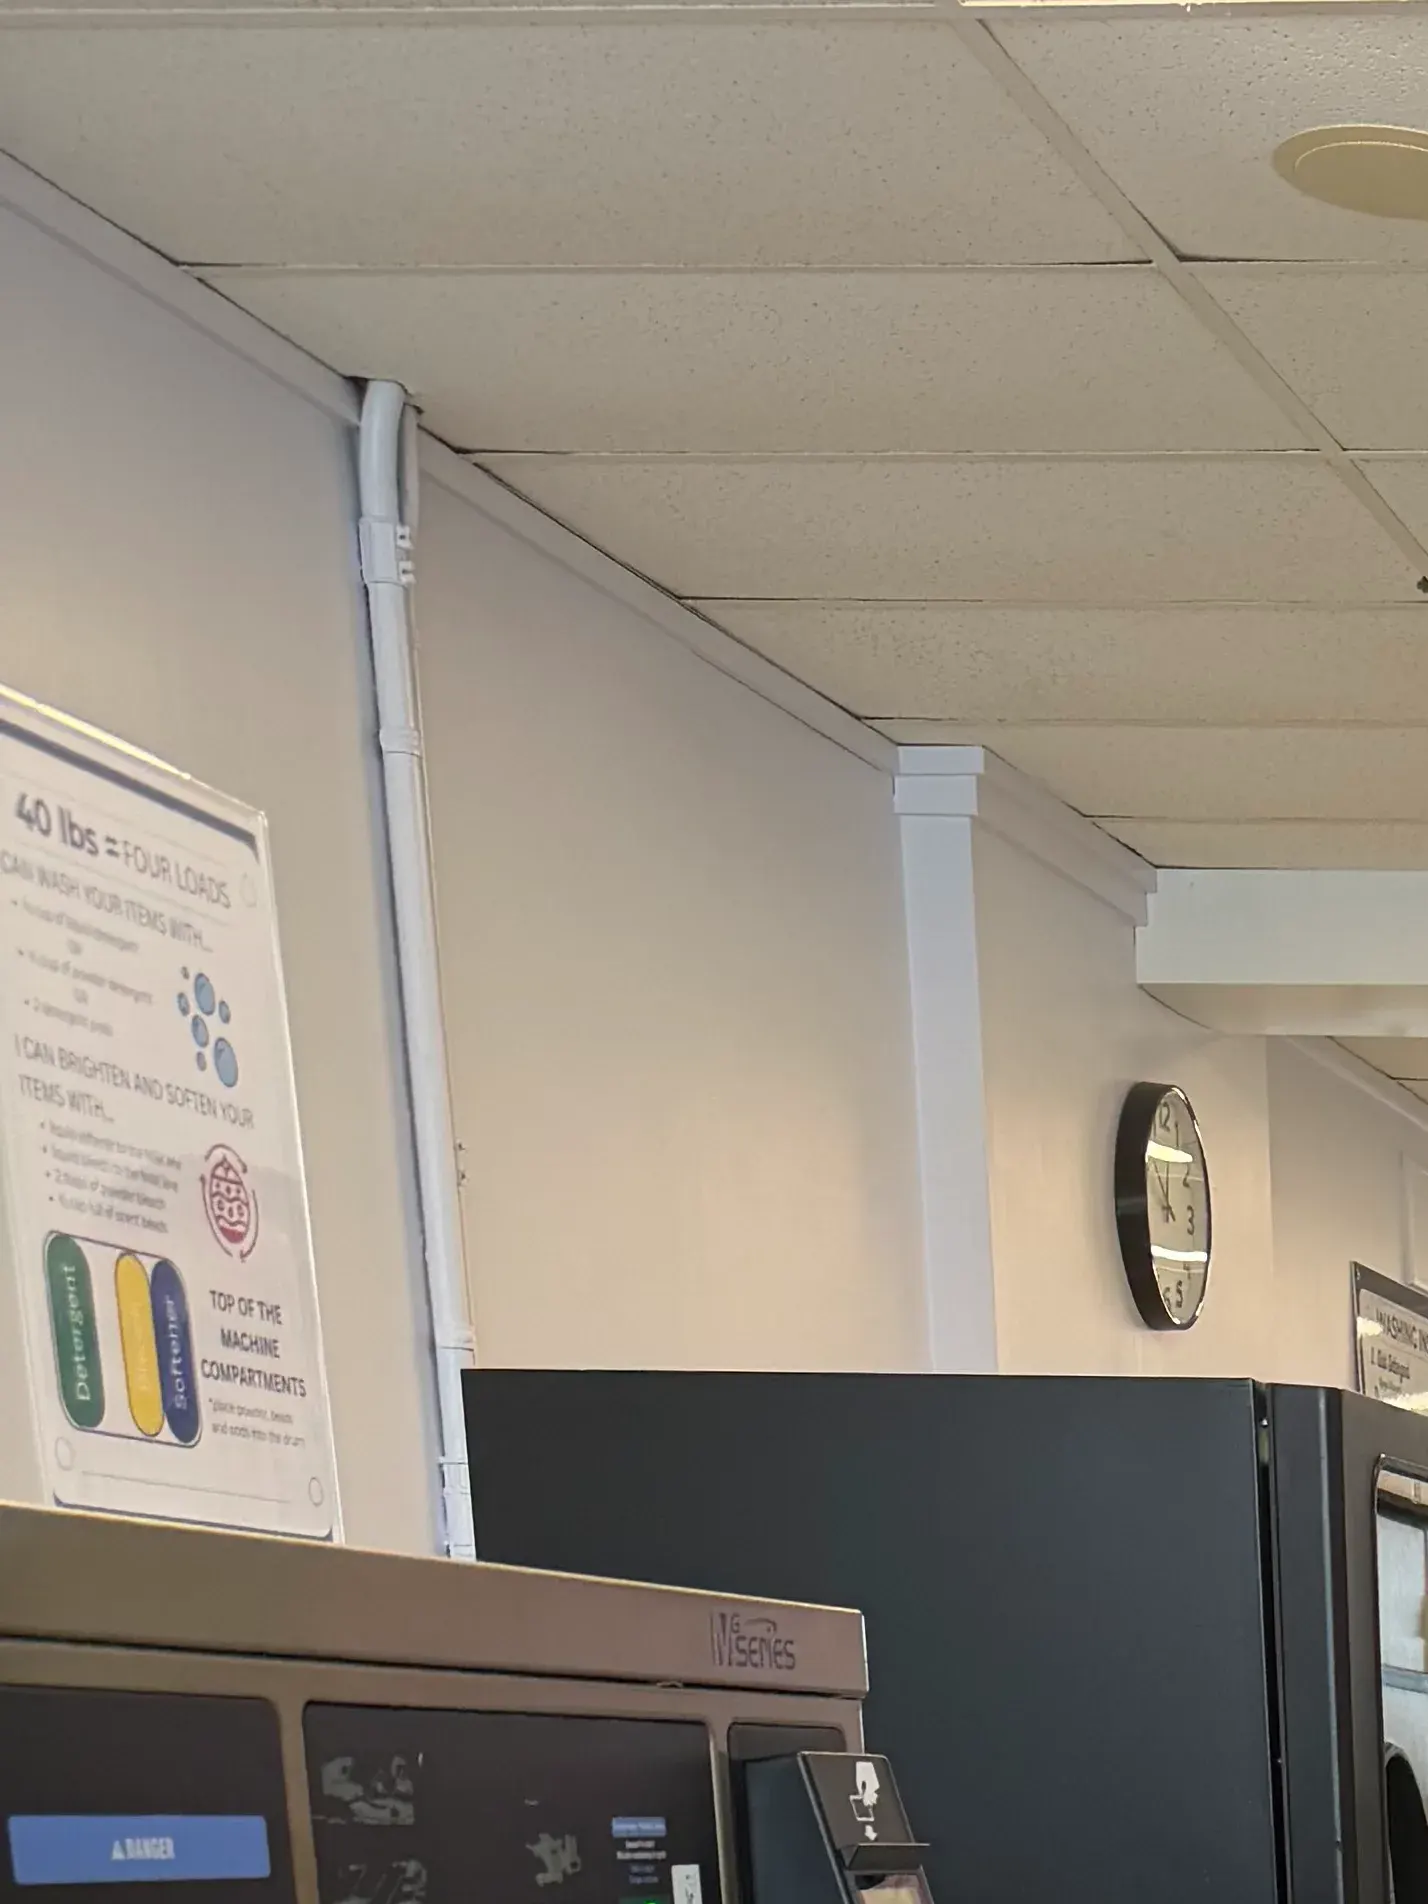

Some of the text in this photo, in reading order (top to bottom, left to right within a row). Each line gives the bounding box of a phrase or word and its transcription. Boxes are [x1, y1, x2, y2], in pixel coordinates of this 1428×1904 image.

[15, 793, 51, 837] 40
[58, 805, 99, 857] lbs
[122, 840, 173, 886] FOUR
[176, 861, 232, 910] LOADS
[37, 865, 81, 899] WASH
[83, 884, 123, 917] YOUR
[124, 899, 167, 937] ITEMS
[18, 1073, 66, 1108] ITEMS
[23, 1036, 56, 1067] CAN
[57, 1047, 131, 1091] BRIGHTEN
[134, 1073, 164, 1101] AND
[165, 1082, 219, 1119] SOFTEN
[220, 1101, 255, 1129] YOUR
[1158, 1101, 1171, 1132] 12
[1186, 1205, 1196, 1236] 3
[209, 1289, 283, 1327] TOP OF THE
[1376, 1306, 1418, 1350] WASHING
[62, 1264, 92, 1401] Detergent
[165, 1294, 188, 1411] Softener
[220, 1327, 281, 1360] MACHINE
[200, 1358, 308, 1399] COMPARTMENTS
